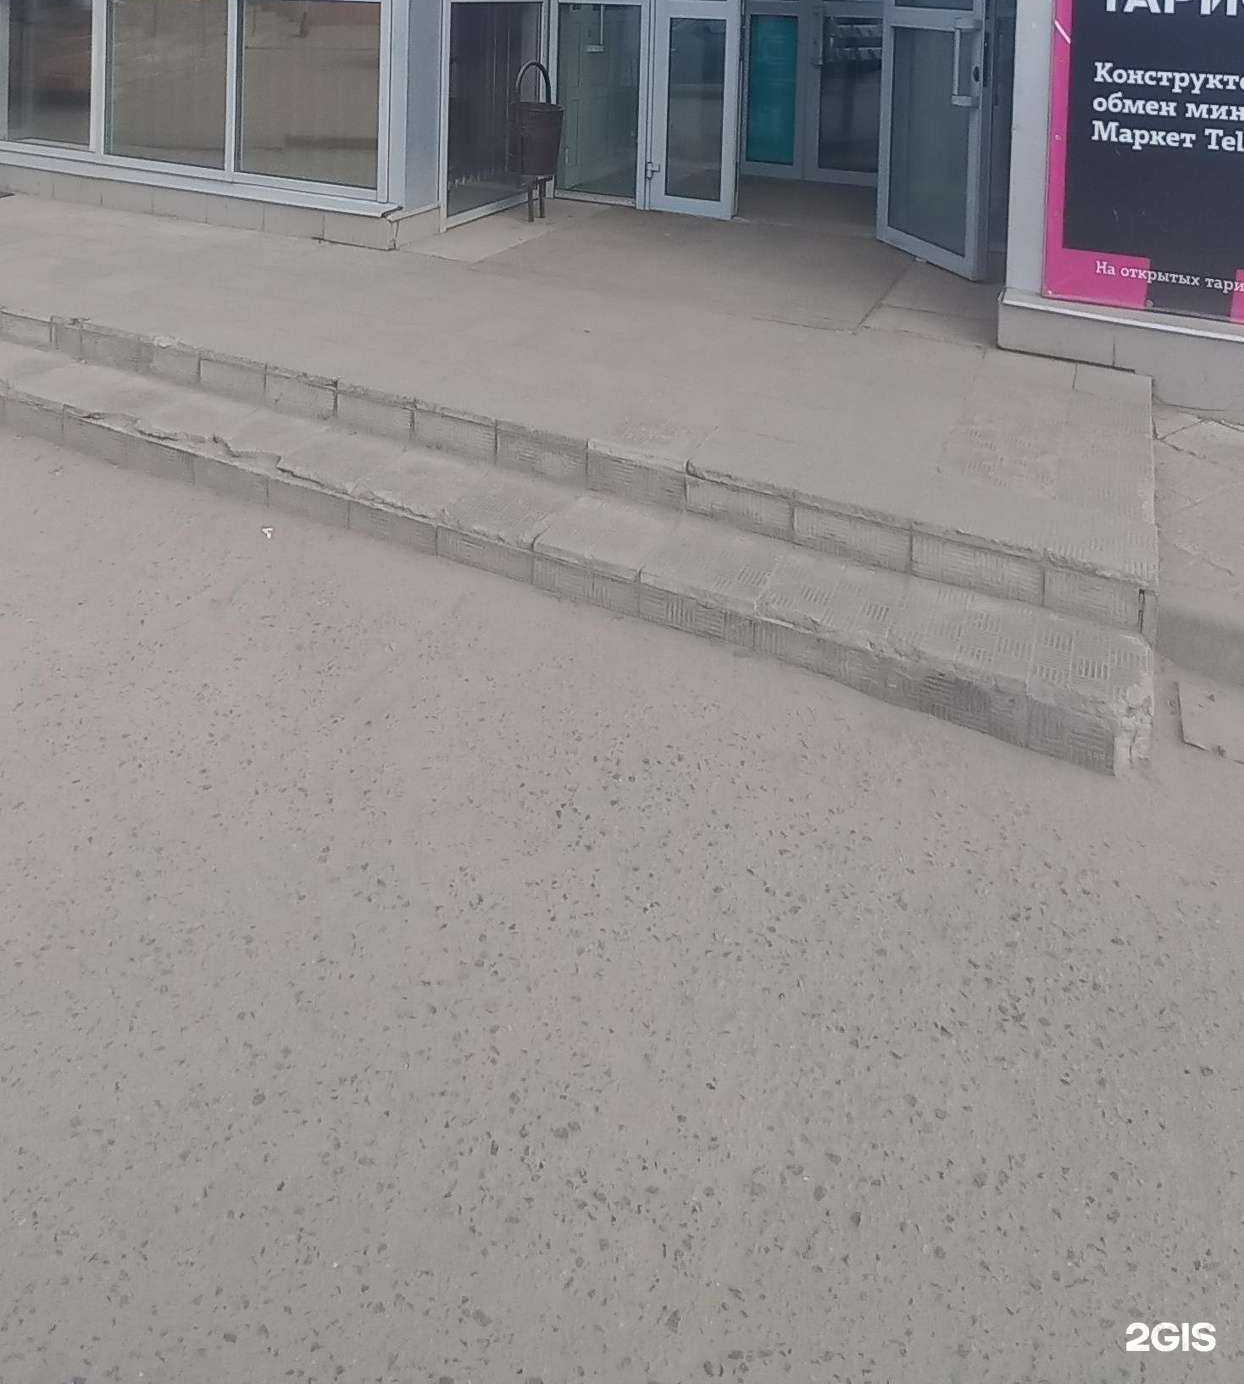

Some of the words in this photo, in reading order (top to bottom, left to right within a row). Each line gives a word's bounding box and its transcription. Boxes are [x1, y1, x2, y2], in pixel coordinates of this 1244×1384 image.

[1092, 91, 1177, 116] обмен
[1185, 102, 1244, 121] мин
[1091, 120, 1196, 150] Маркет
[1204, 127, 1244, 152] Tel
[1095, 259, 1116, 276] На
[1120, 266, 1201, 286] открытых
[1204, 276, 1244, 294] тари
